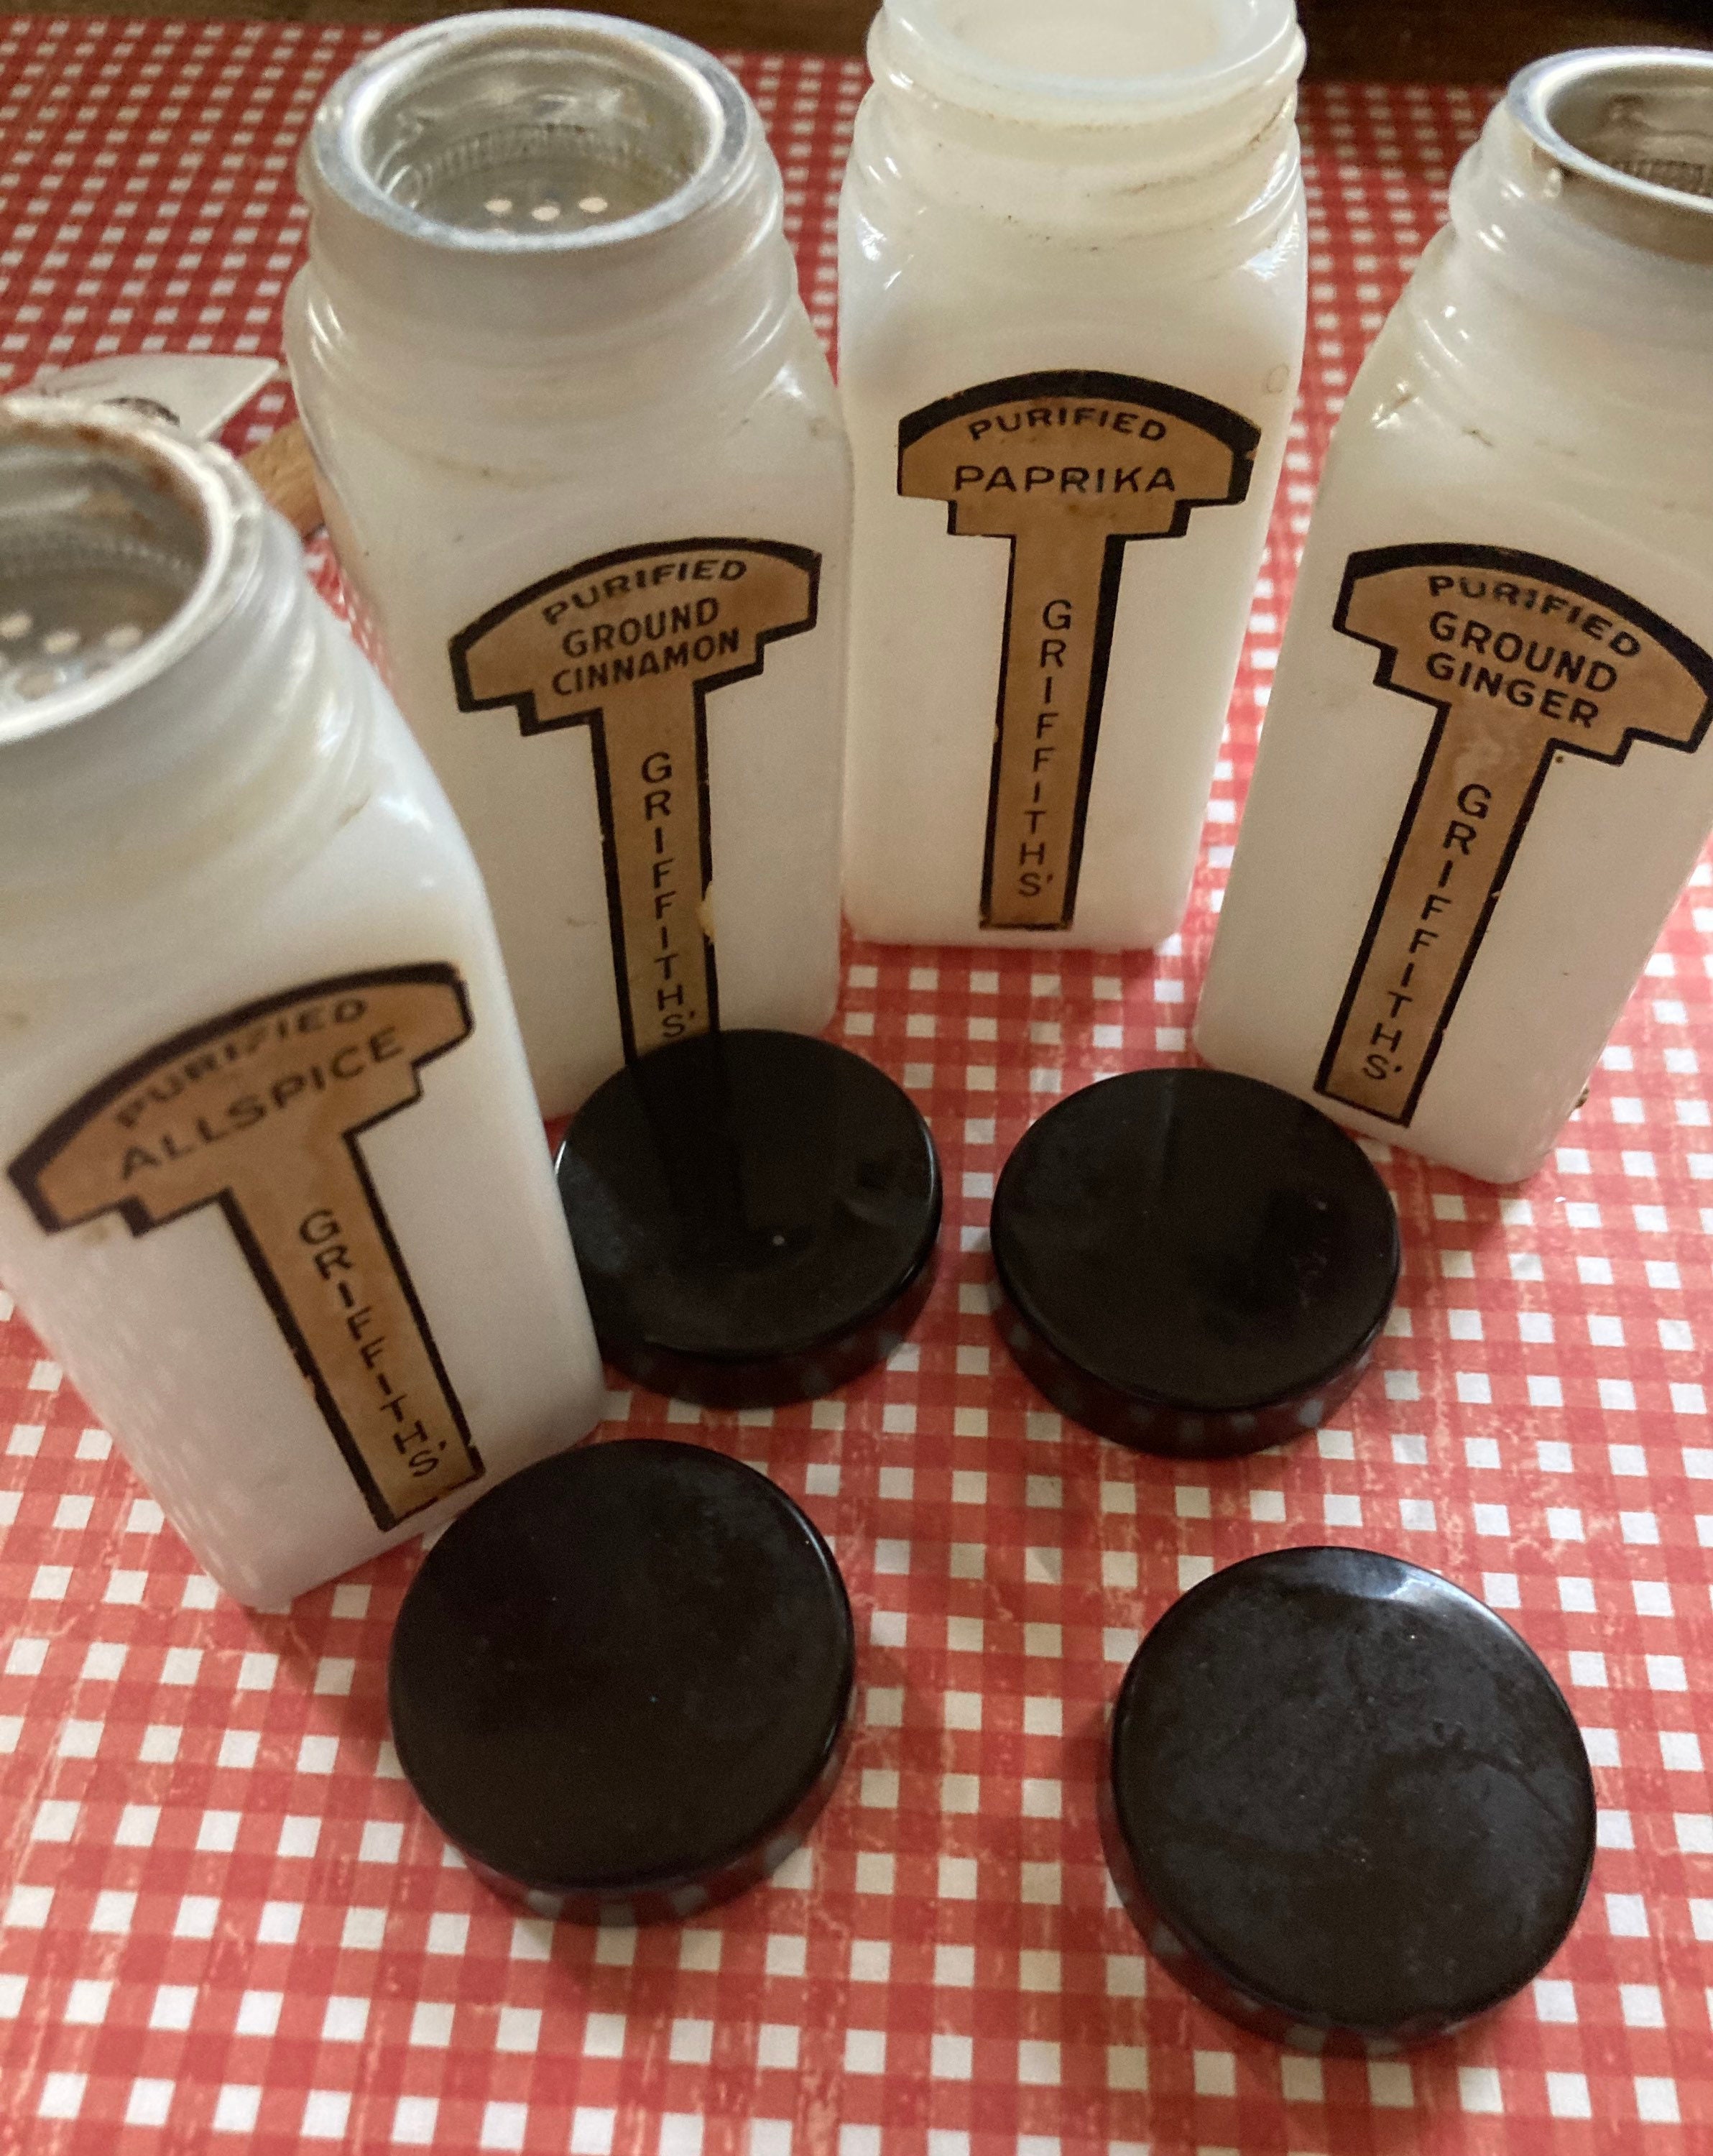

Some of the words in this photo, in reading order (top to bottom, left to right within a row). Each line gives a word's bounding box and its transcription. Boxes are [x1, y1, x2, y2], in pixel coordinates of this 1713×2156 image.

[969, 407, 1167, 442] PURIFIED
[954, 465, 1176, 494] PAPRIKA
[542, 558, 747, 625] PURIFIED
[563, 596, 719, 658] GROUND
[1428, 575, 1642, 659] PURIFIED
[553, 627, 740, 696] CINNAMON
[1429, 610, 1618, 694] GROUND
[1426, 652, 1600, 729] GINGER
[116, 998, 368, 1131] PURIFIED
[121, 1026, 404, 1181] ALLSPICE
